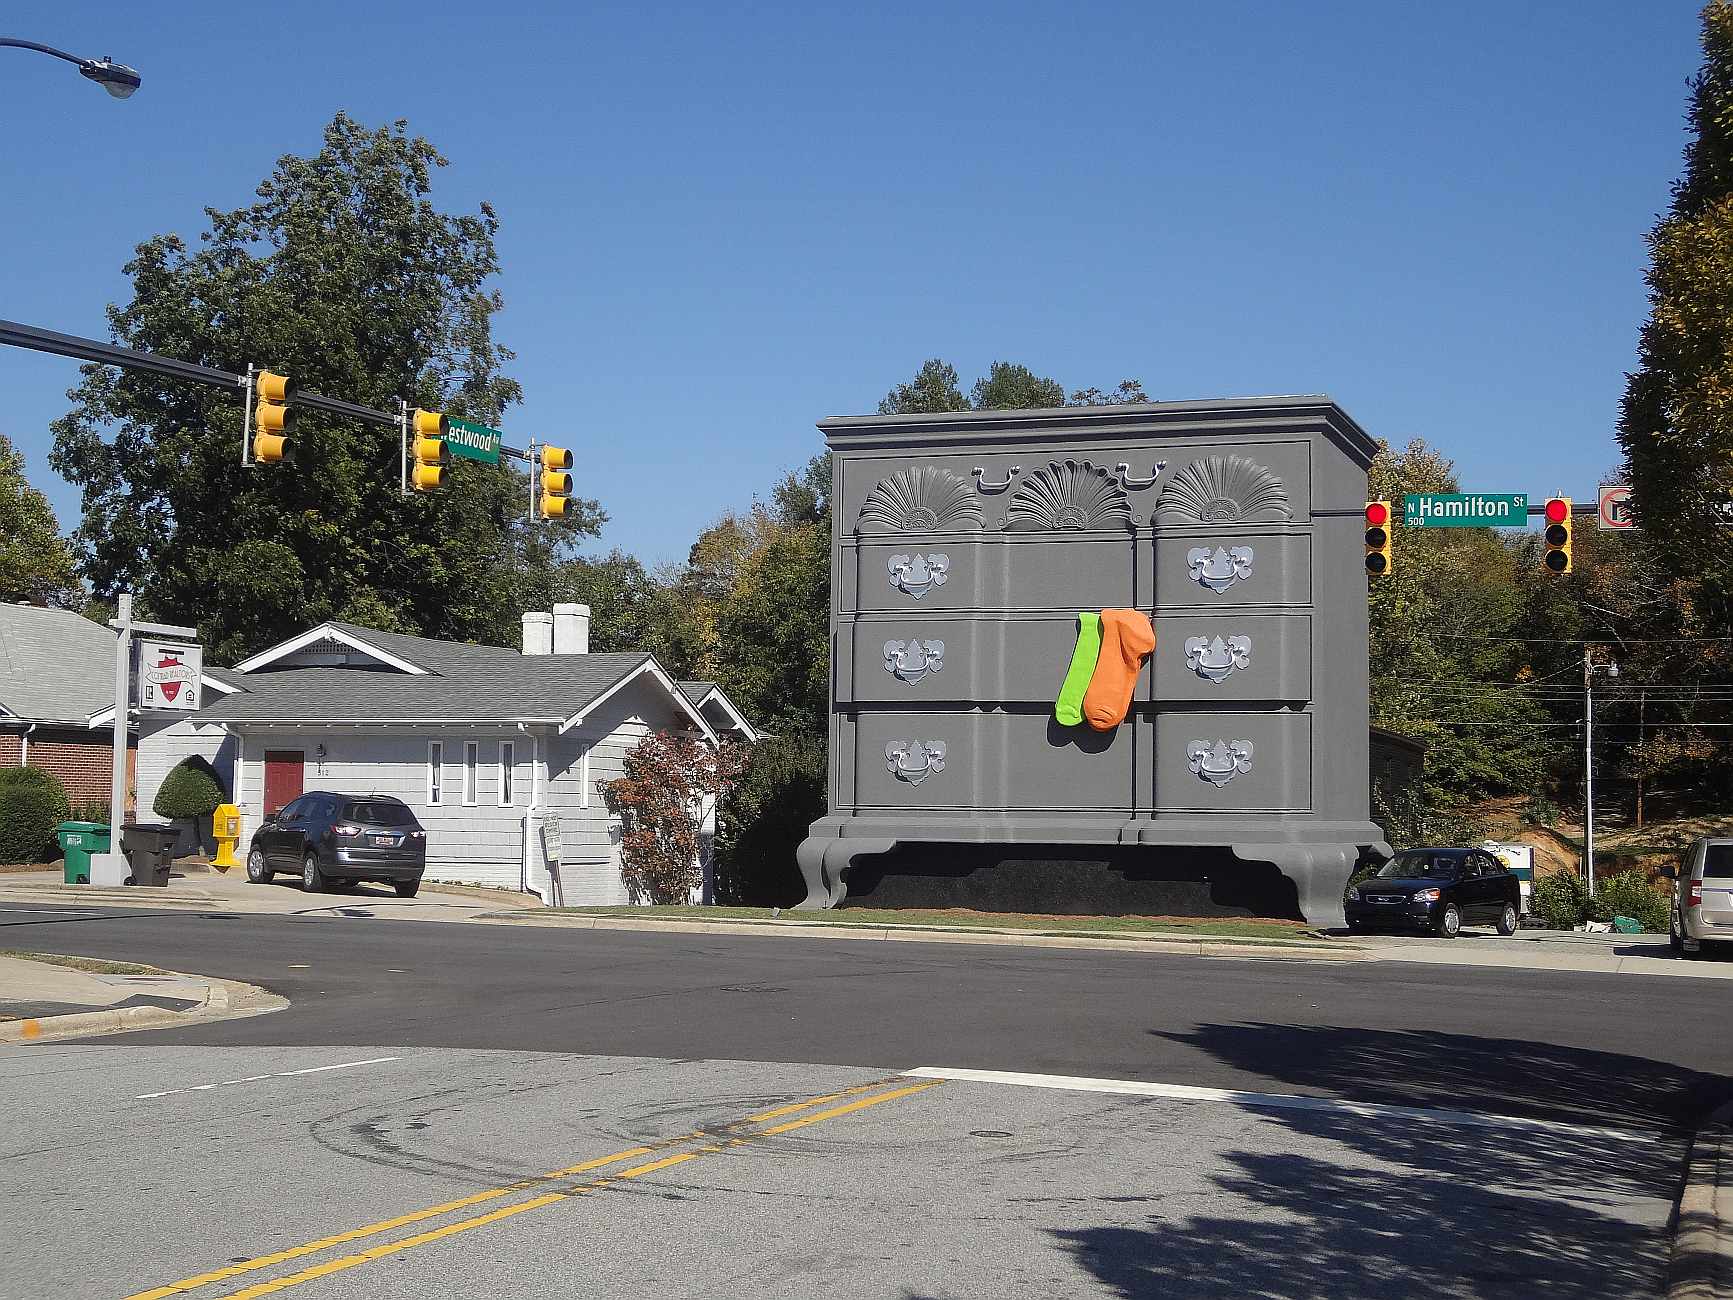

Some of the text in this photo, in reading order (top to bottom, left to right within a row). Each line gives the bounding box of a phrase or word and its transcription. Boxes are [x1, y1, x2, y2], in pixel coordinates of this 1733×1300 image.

[448, 424, 491, 451] estwood
[1408, 496, 1524, 517] N Hamilton St
[1408, 517, 1424, 526] 500
